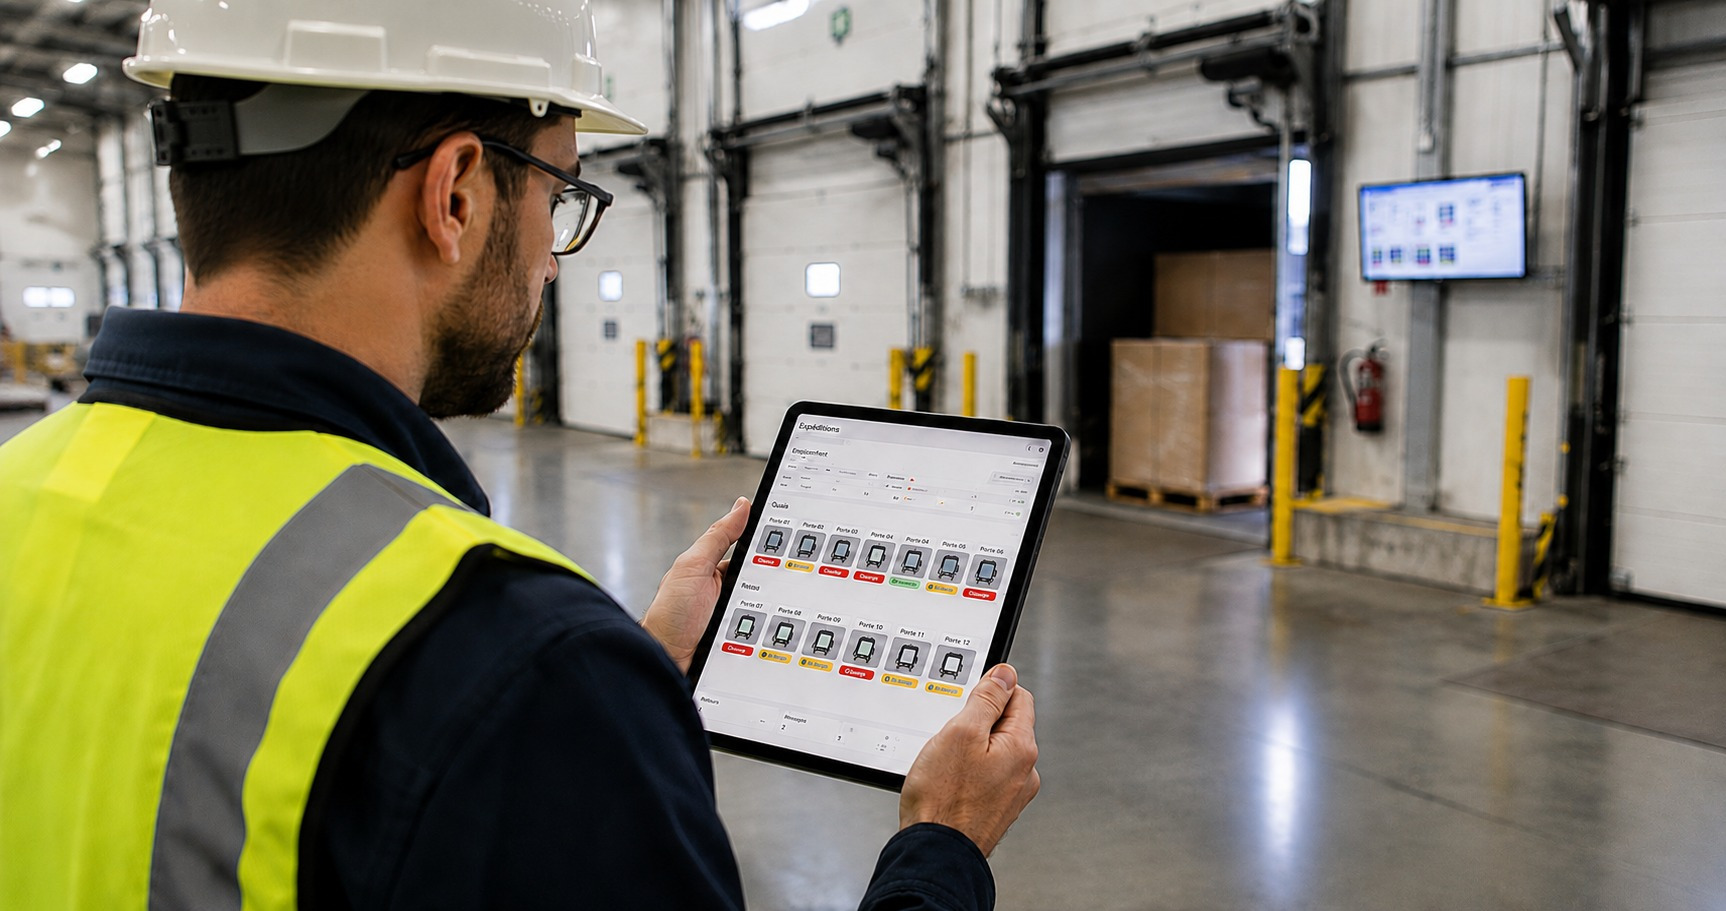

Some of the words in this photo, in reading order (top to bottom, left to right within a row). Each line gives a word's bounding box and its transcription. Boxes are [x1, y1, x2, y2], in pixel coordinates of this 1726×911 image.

[859, 621, 874, 629] Porte
[900, 628, 916, 636] Porte
[944, 636, 961, 644] Porte
